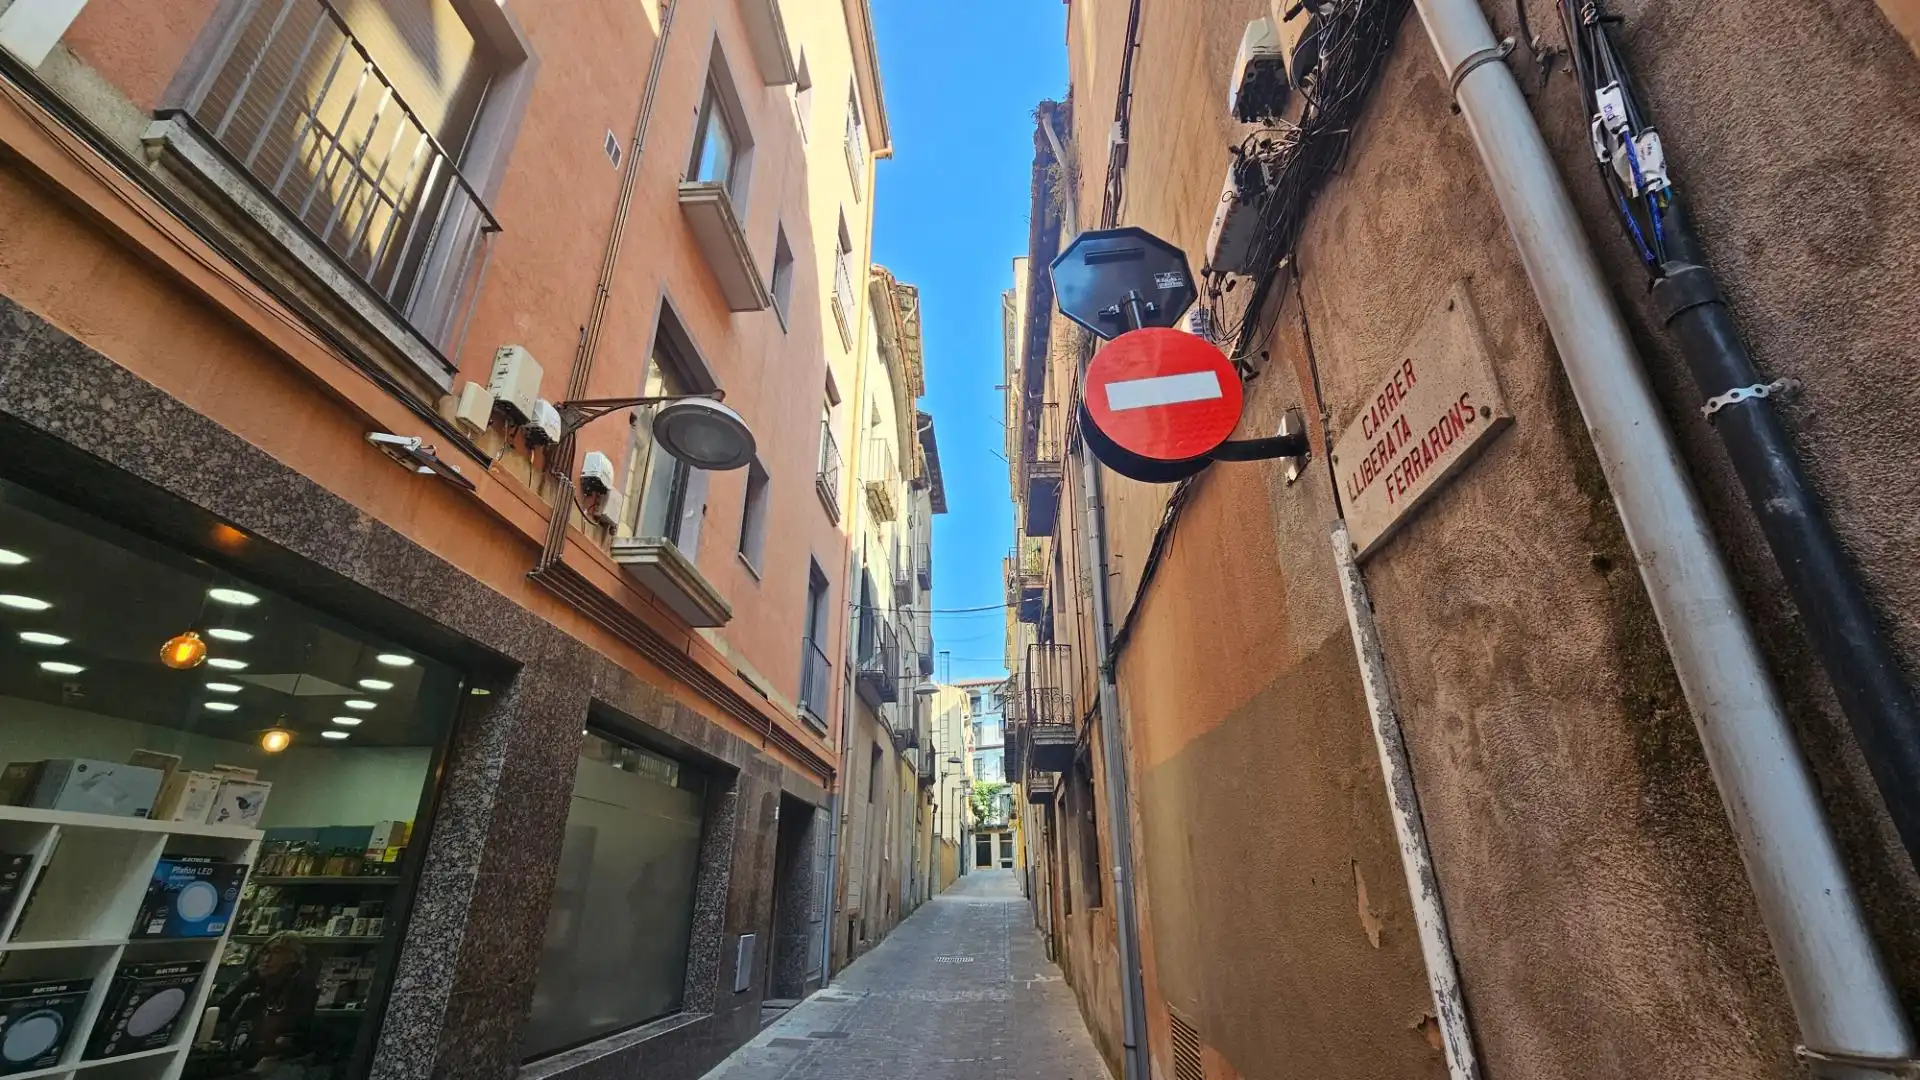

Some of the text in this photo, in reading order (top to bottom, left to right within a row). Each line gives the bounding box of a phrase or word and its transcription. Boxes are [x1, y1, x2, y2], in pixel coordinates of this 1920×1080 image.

[1362, 357, 1417, 440] CARRER
[1347, 413, 1412, 502] LLIBERATA
[1385, 392, 1476, 504] FERRARONS
[171, 866, 213, 875] Plafón LED
